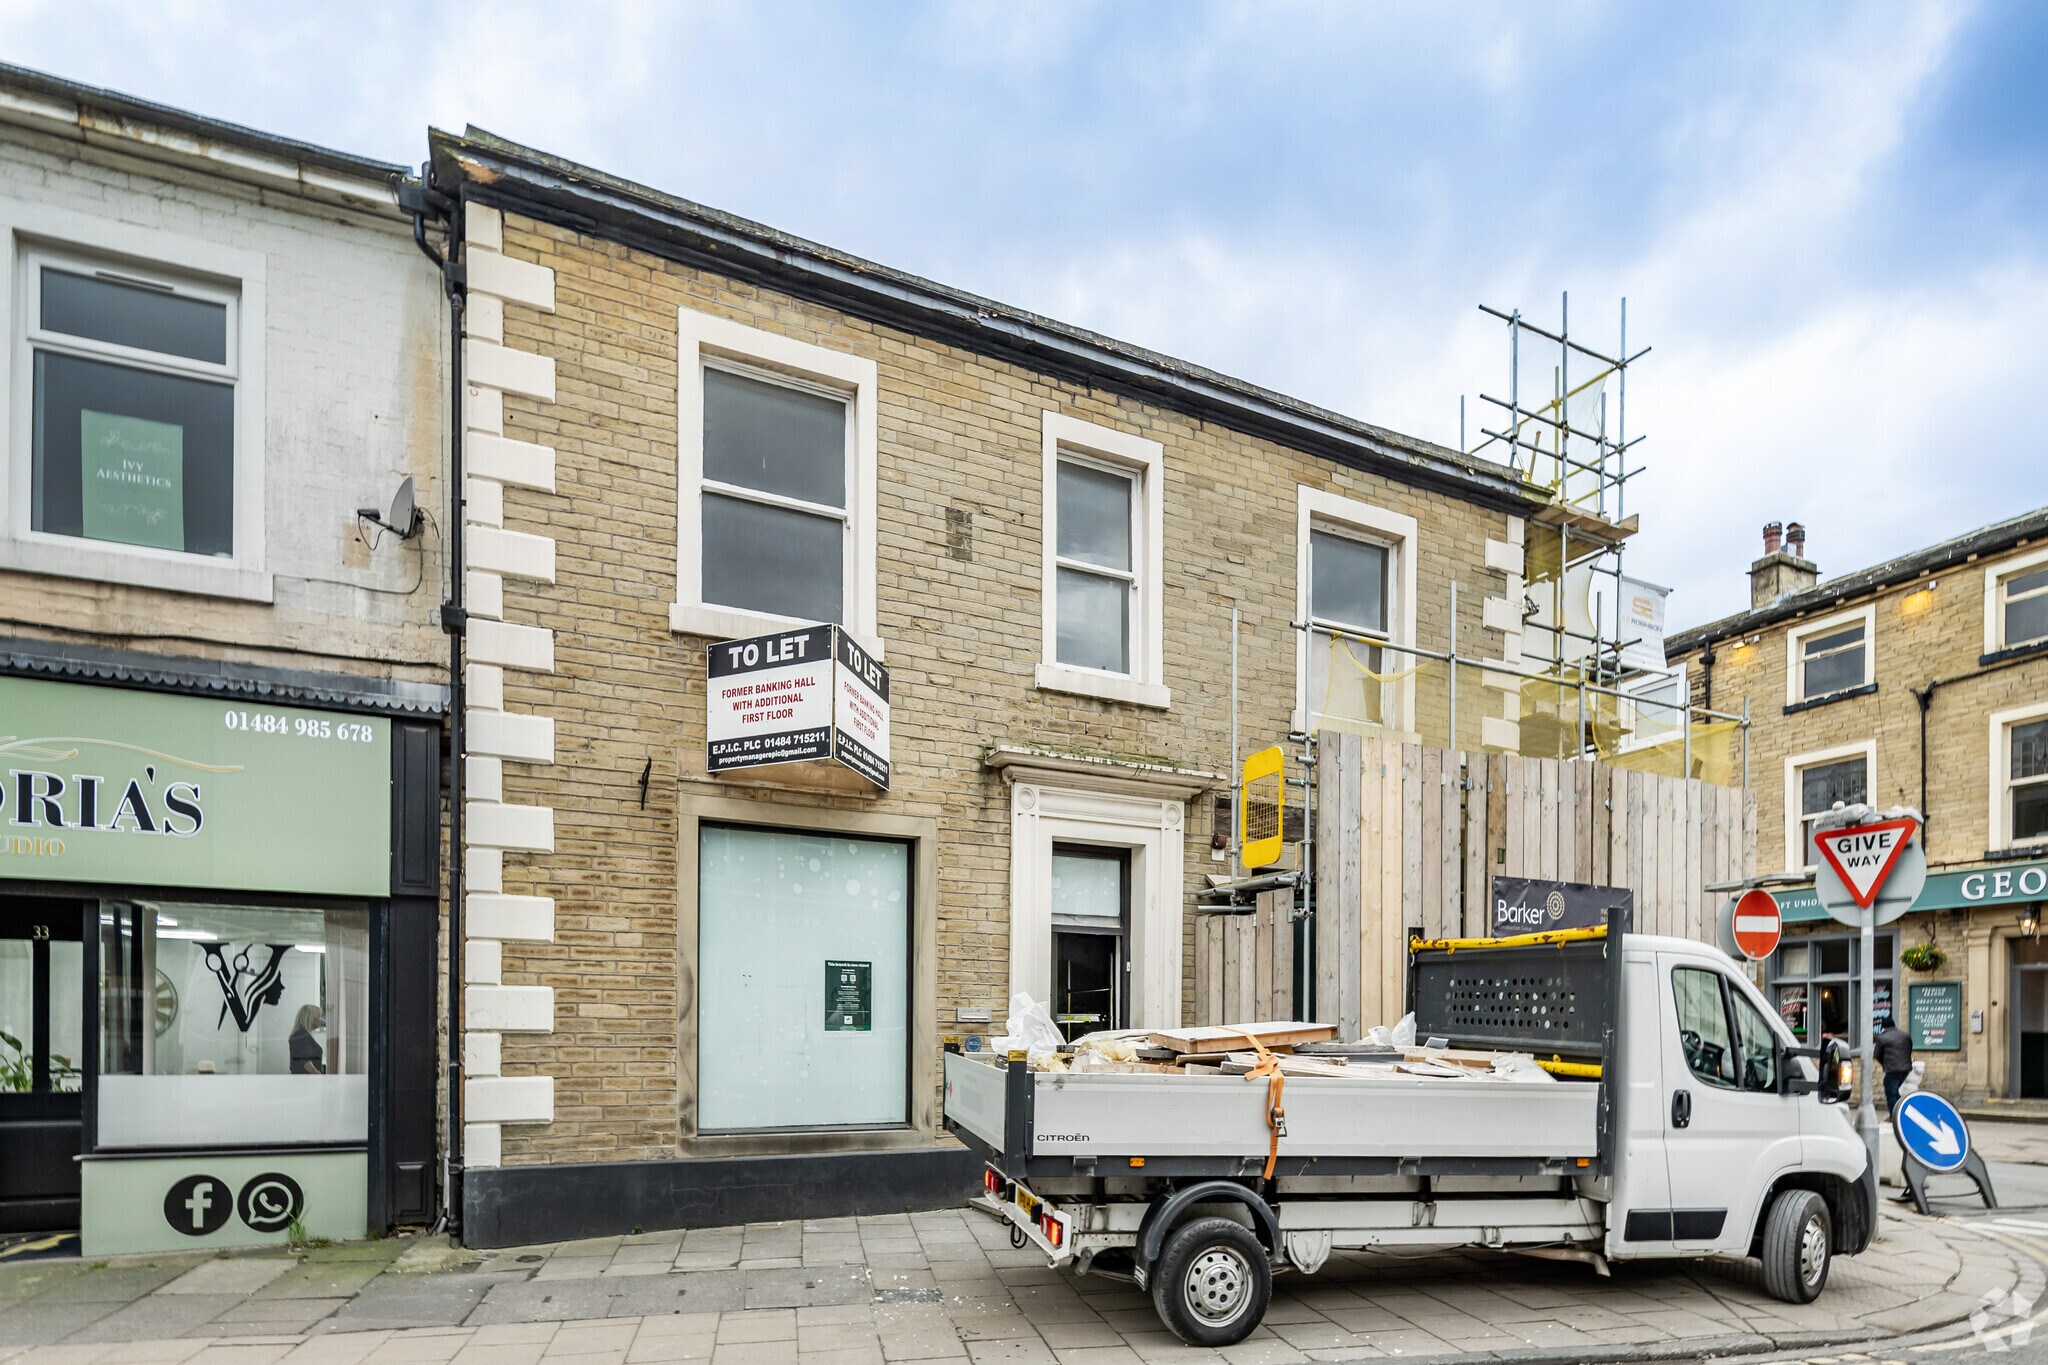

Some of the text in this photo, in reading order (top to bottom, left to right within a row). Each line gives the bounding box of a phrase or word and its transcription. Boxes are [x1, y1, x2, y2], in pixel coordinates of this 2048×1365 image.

[96, 467, 172, 489] AESTHETICS
[728, 634, 810, 669] TO LET
[847, 641, 882, 690] TO LET
[722, 676, 816, 699] FORMER BANKING HALL
[732, 692, 804, 712] WITH ADDITIONAL
[224, 710, 373, 743] 01484 985 678
[742, 708, 794, 724] FIRST FLOOR
[712, 731, 826, 755] E.P.I.C. PLC 01484 715211
[0, 764, 204, 838] RIA'S
[1837, 832, 1892, 854] GIVE
[1847, 854, 1881, 868] WAY
[1960, 868, 2047, 900] GEO
[1497, 898, 1546, 924] Barker
[32, 925, 50, 940] 33
